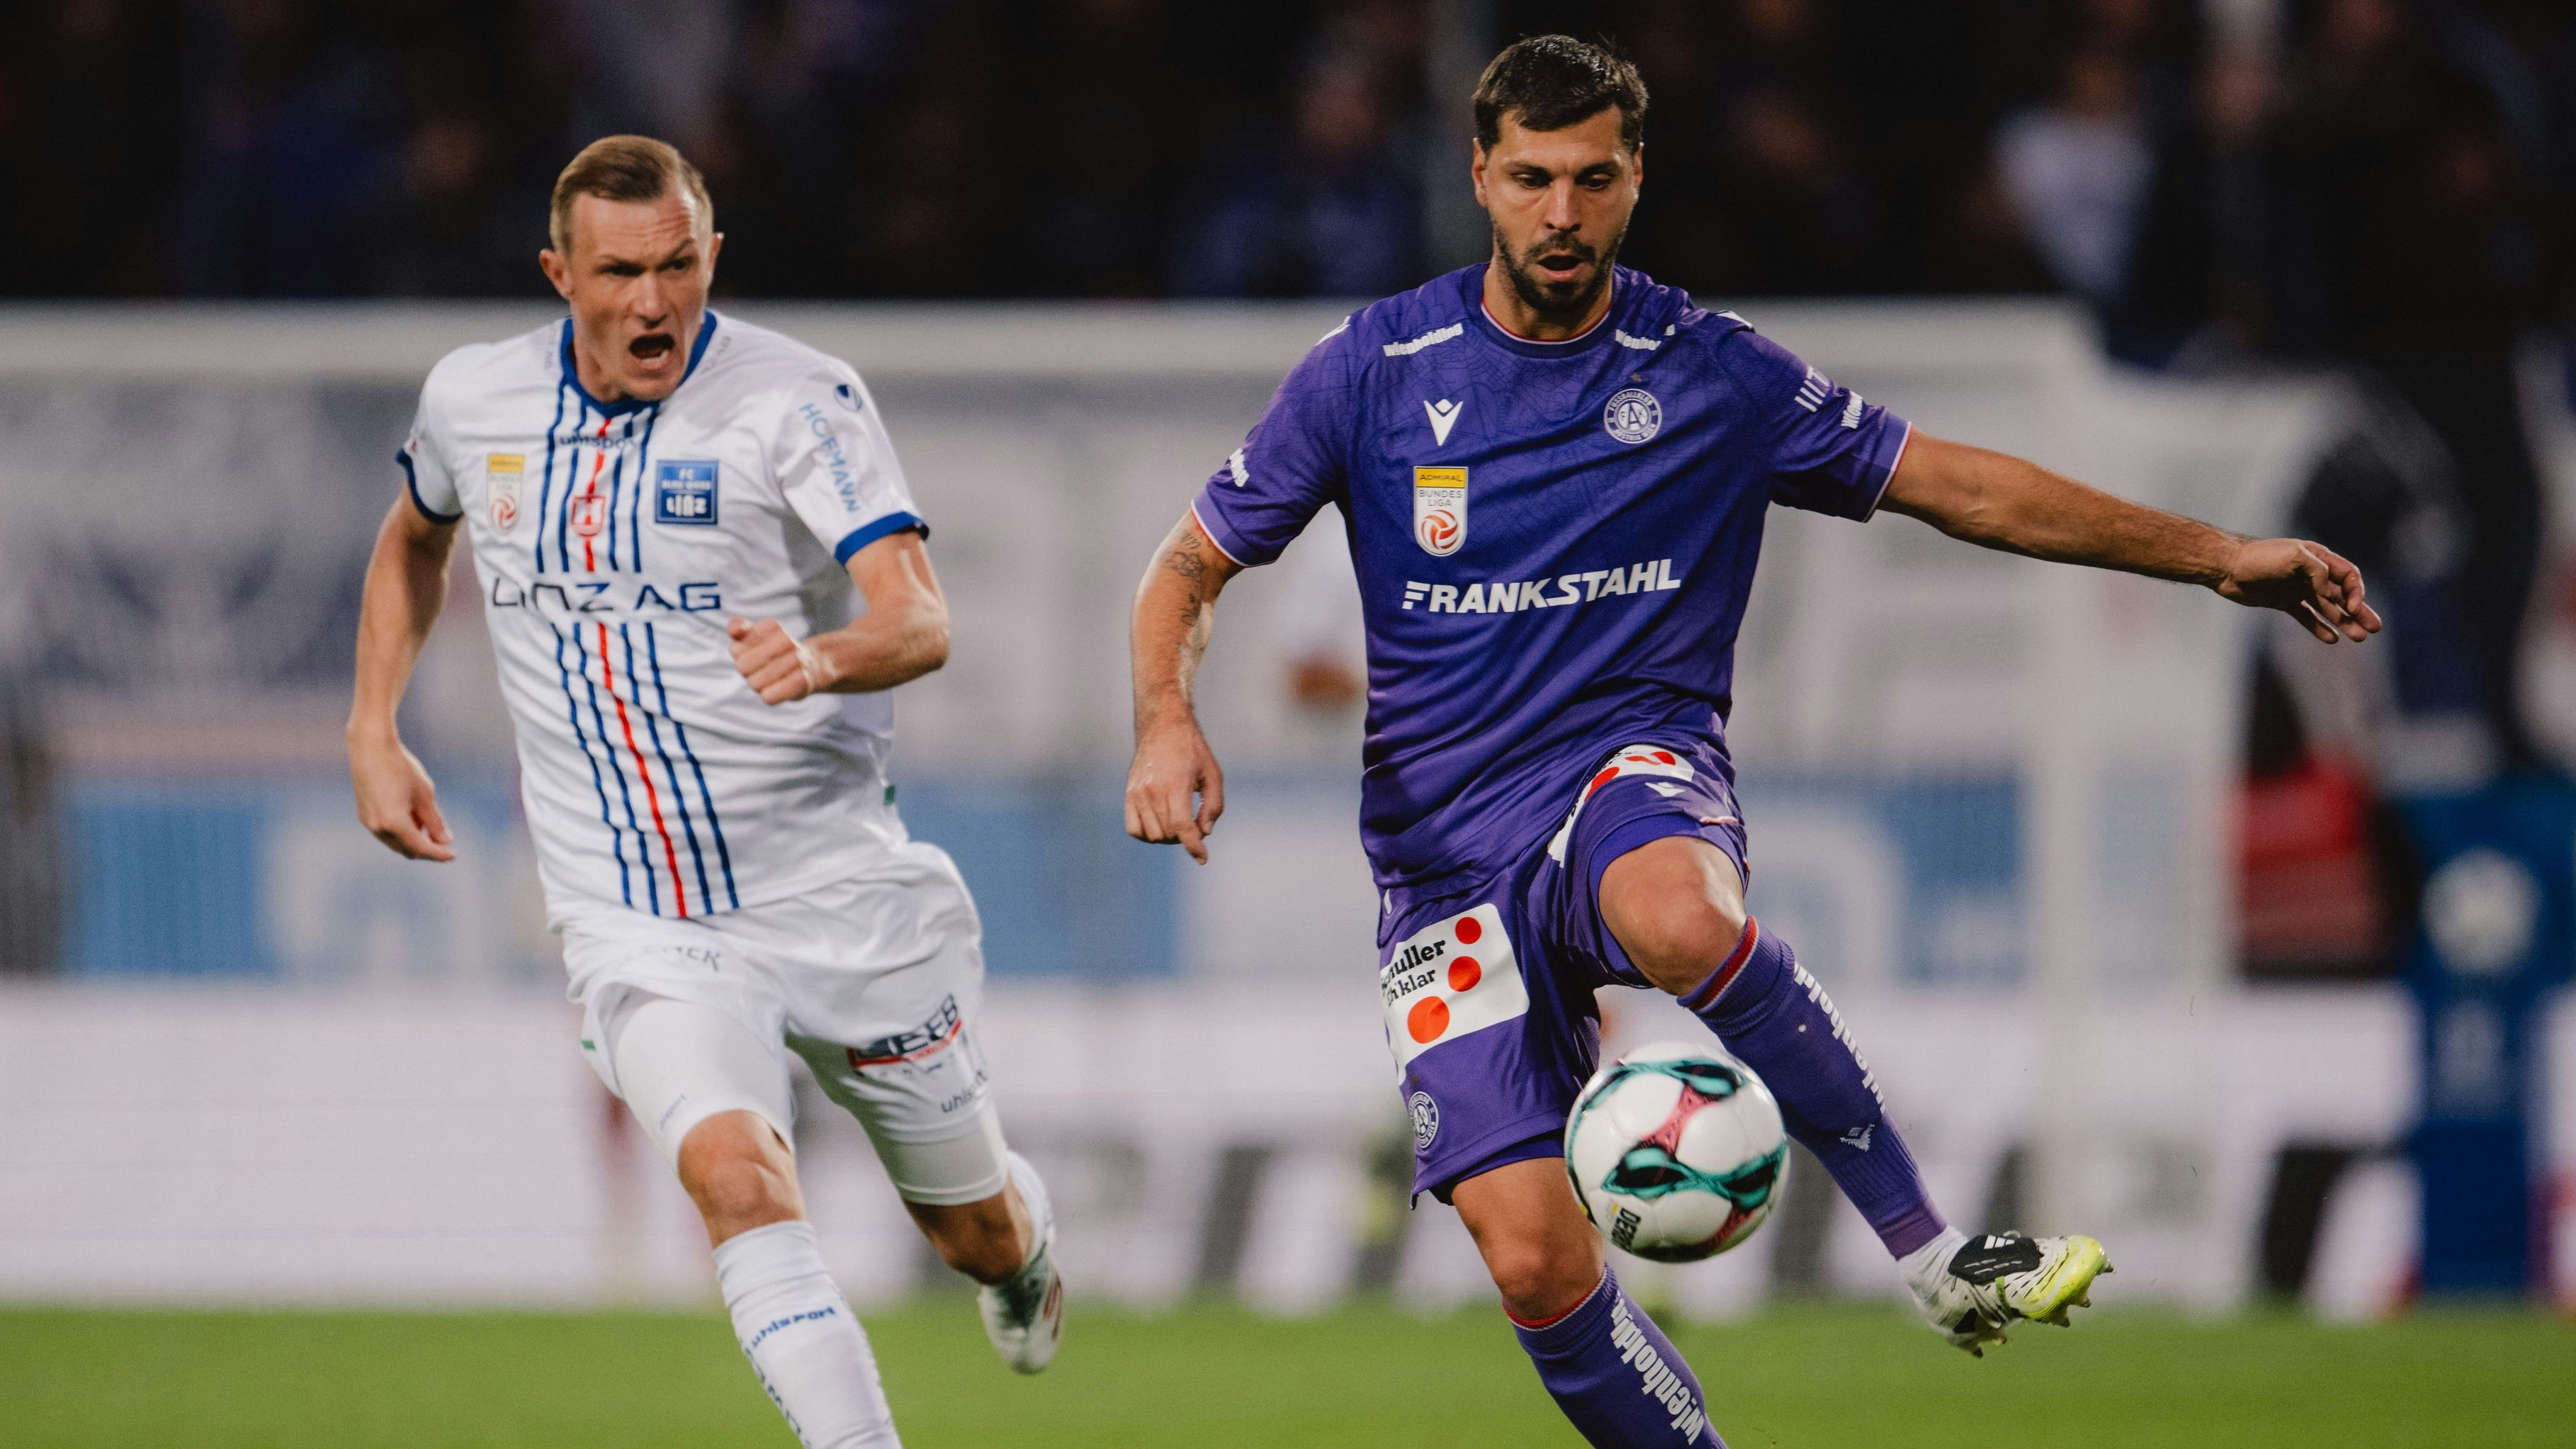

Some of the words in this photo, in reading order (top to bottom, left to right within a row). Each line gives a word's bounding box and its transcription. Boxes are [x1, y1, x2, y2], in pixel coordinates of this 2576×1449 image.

[1420, 474, 1463, 483] ADMIRAL
[1419, 490, 1463, 499] BUNDES
[1428, 499, 1452, 507] LIGA
[1402, 558, 1681, 614] FRANKSTAHL
[634, 582, 721, 612] AG
